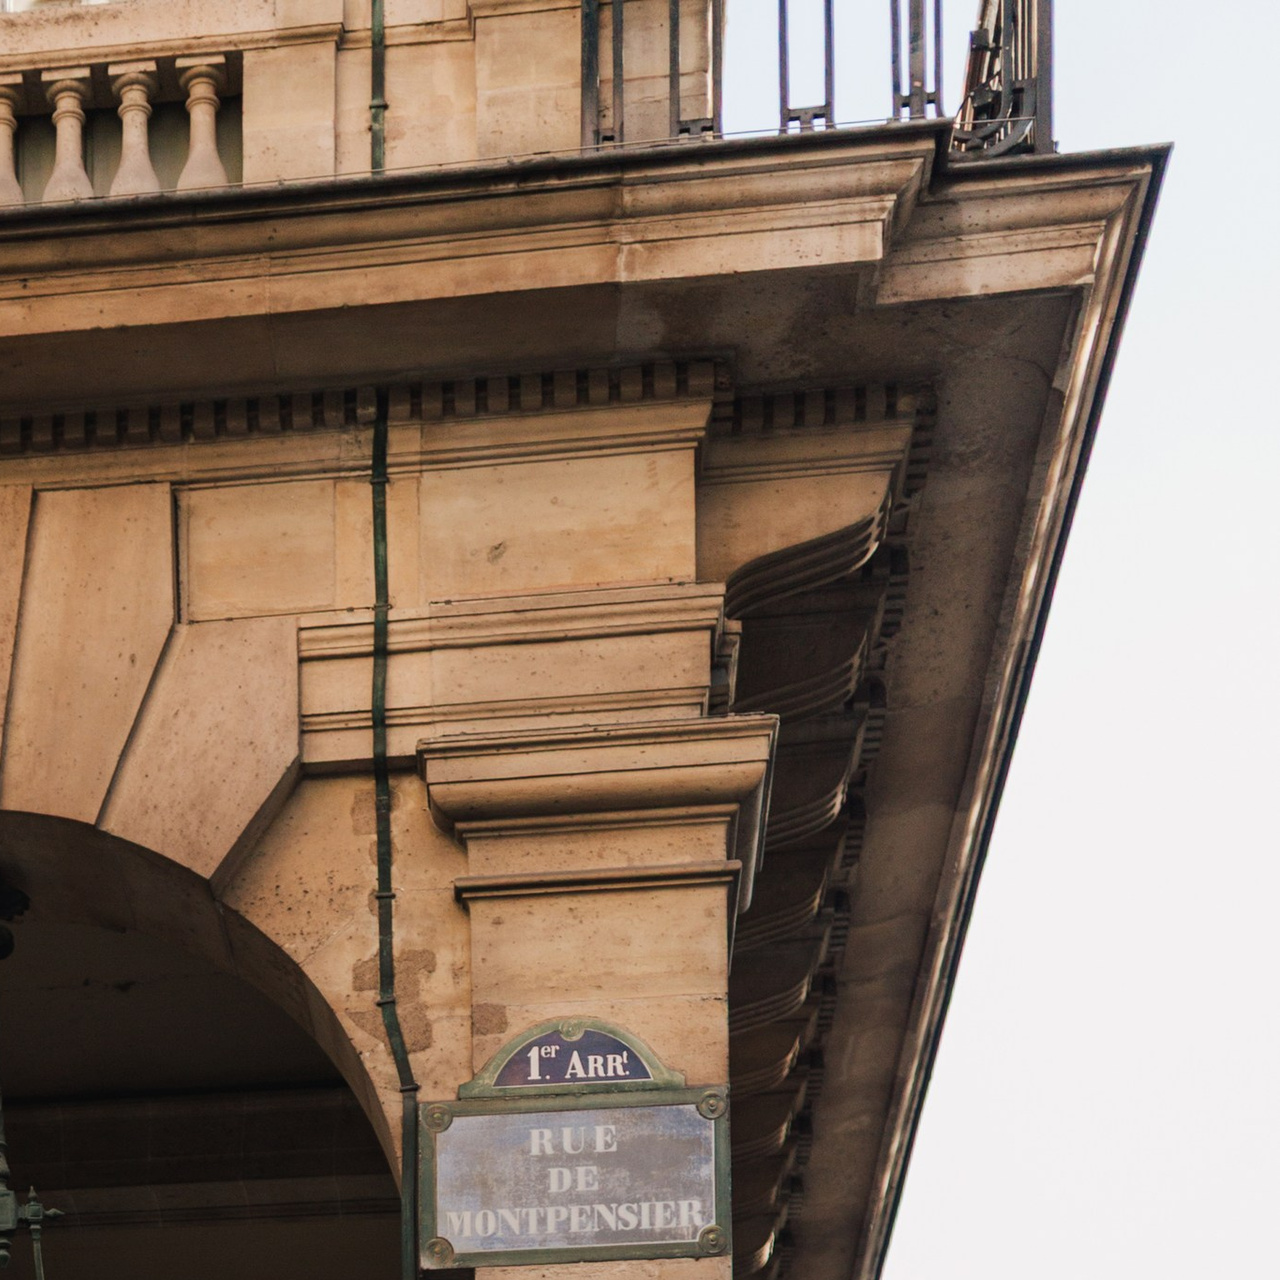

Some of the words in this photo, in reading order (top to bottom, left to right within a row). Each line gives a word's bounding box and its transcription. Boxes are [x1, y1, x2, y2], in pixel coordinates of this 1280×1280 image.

[530, 1125, 617, 1156] RUE
[548, 1166, 598, 1193] DE
[446, 1200, 703, 1238] MONTPENSIER
